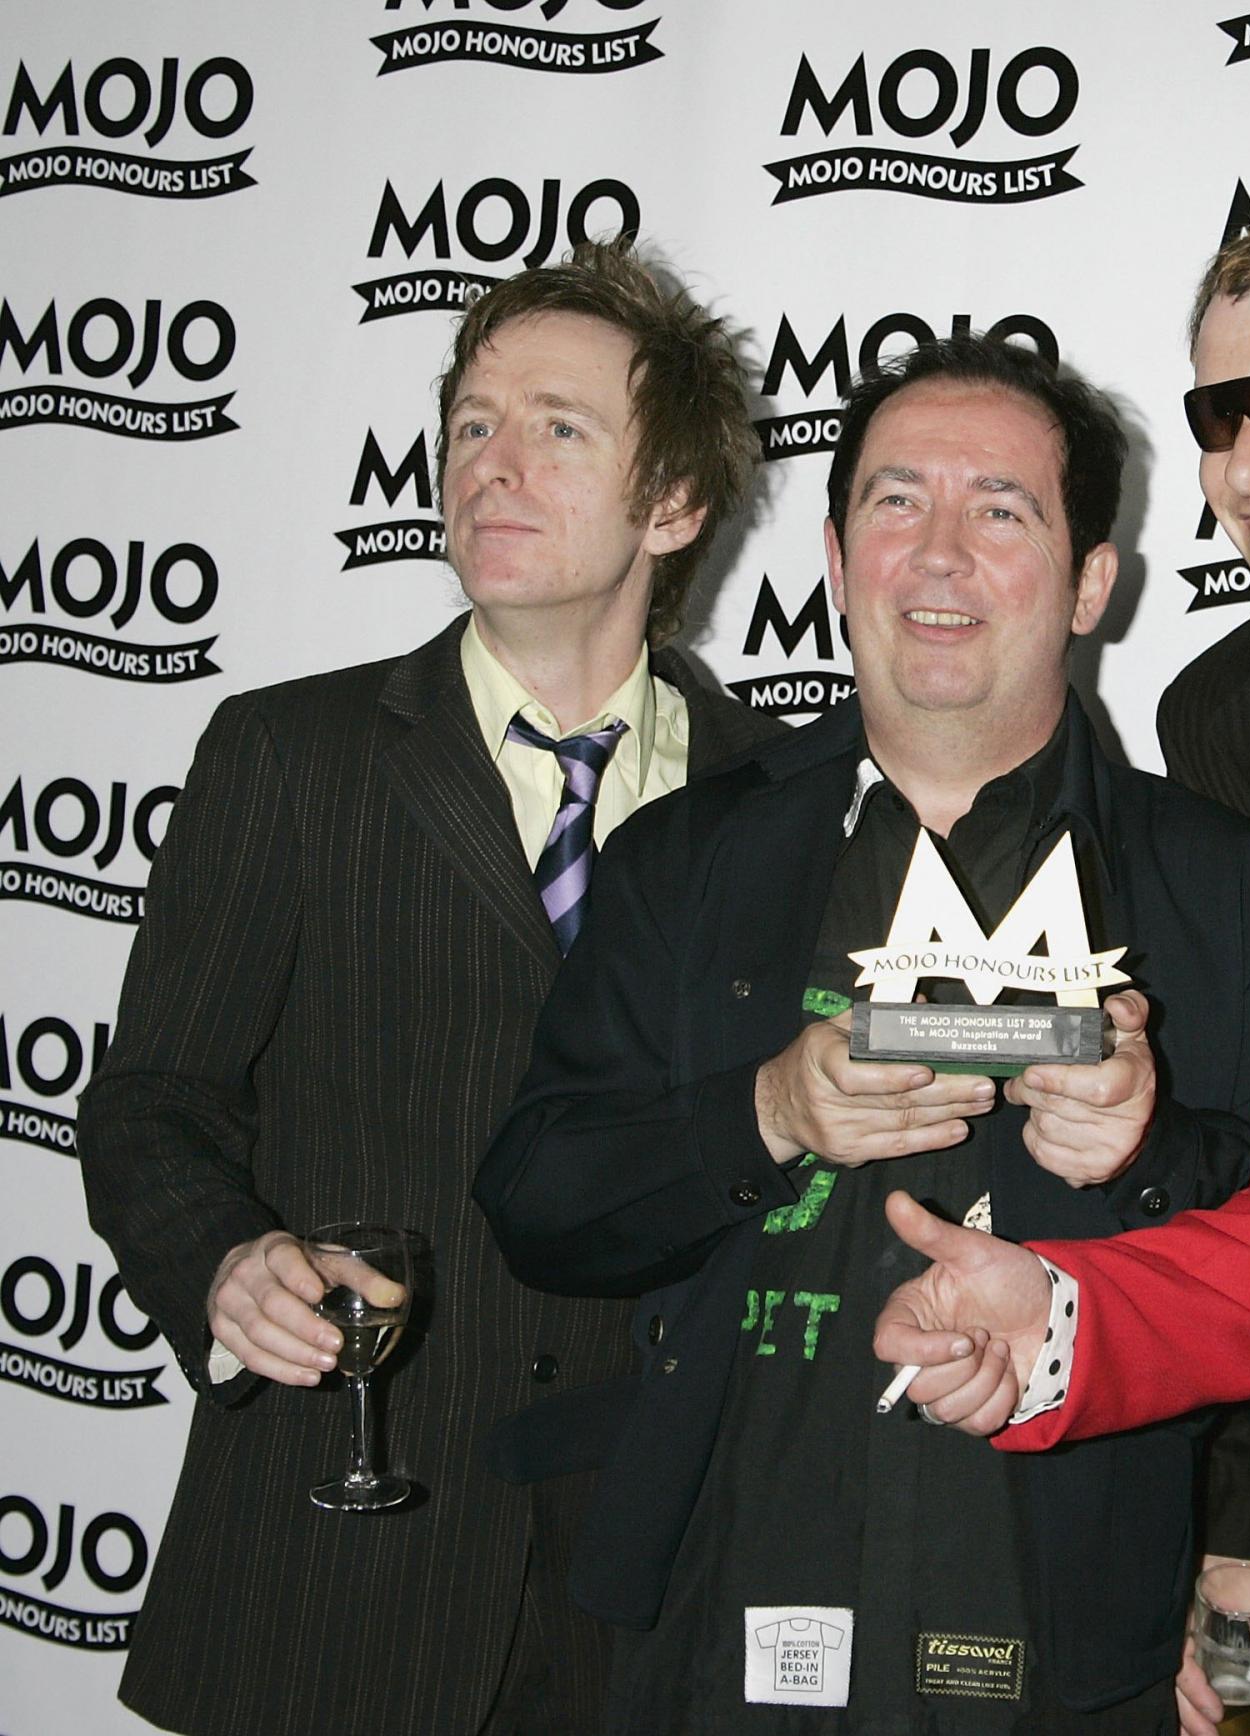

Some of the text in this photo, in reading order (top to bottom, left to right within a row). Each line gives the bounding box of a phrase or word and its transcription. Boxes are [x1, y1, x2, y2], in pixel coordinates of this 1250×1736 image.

[393, 30, 639, 66] MOJO HONOURS LIST
[3, 57, 253, 148] MOJO
[780, 47, 1079, 148] MOJO
[9, 155, 233, 192] MOJO HONOURS LIST
[789, 157, 1055, 195] MOJO HONOURS LIST
[367, 177, 640, 270] MOJO
[375, 279, 441, 307] MOJO
[0, 298, 236, 389] MOJO
[59, 396, 166, 433] HONOURS
[173, 406, 216, 432] LIST
[769, 418, 842, 448] MOJO
[357, 528, 423, 555] MOJO
[0, 538, 218, 630] MOJO
[0, 632, 199, 675] OJO HONOURS LIST
[751, 680, 825, 708] MOJO
[25, 875, 133, 917] HONOURS
[873, 952, 1105, 982] MOJO HONOURS LIST
[899, 1015, 1053, 1029] THE MOJO HONOURS LIST 2006
[909, 1027, 1042, 1041] The MOJO Inspiration Award
[951, 1041, 997, 1051] Buzzcocks
[8, 1112, 77, 1149] HONO
[0, 1255, 161, 1352] OJO
[104, 1378, 146, 1400] LIST
[0, 1495, 148, 1593] OJO
[0, 1598, 129, 1643] NOURS LIST
[781, 1649, 819, 1660] JERSEY
[926, 1663, 951, 1673] PILE
[928, 1639, 1014, 1660] tissavel
